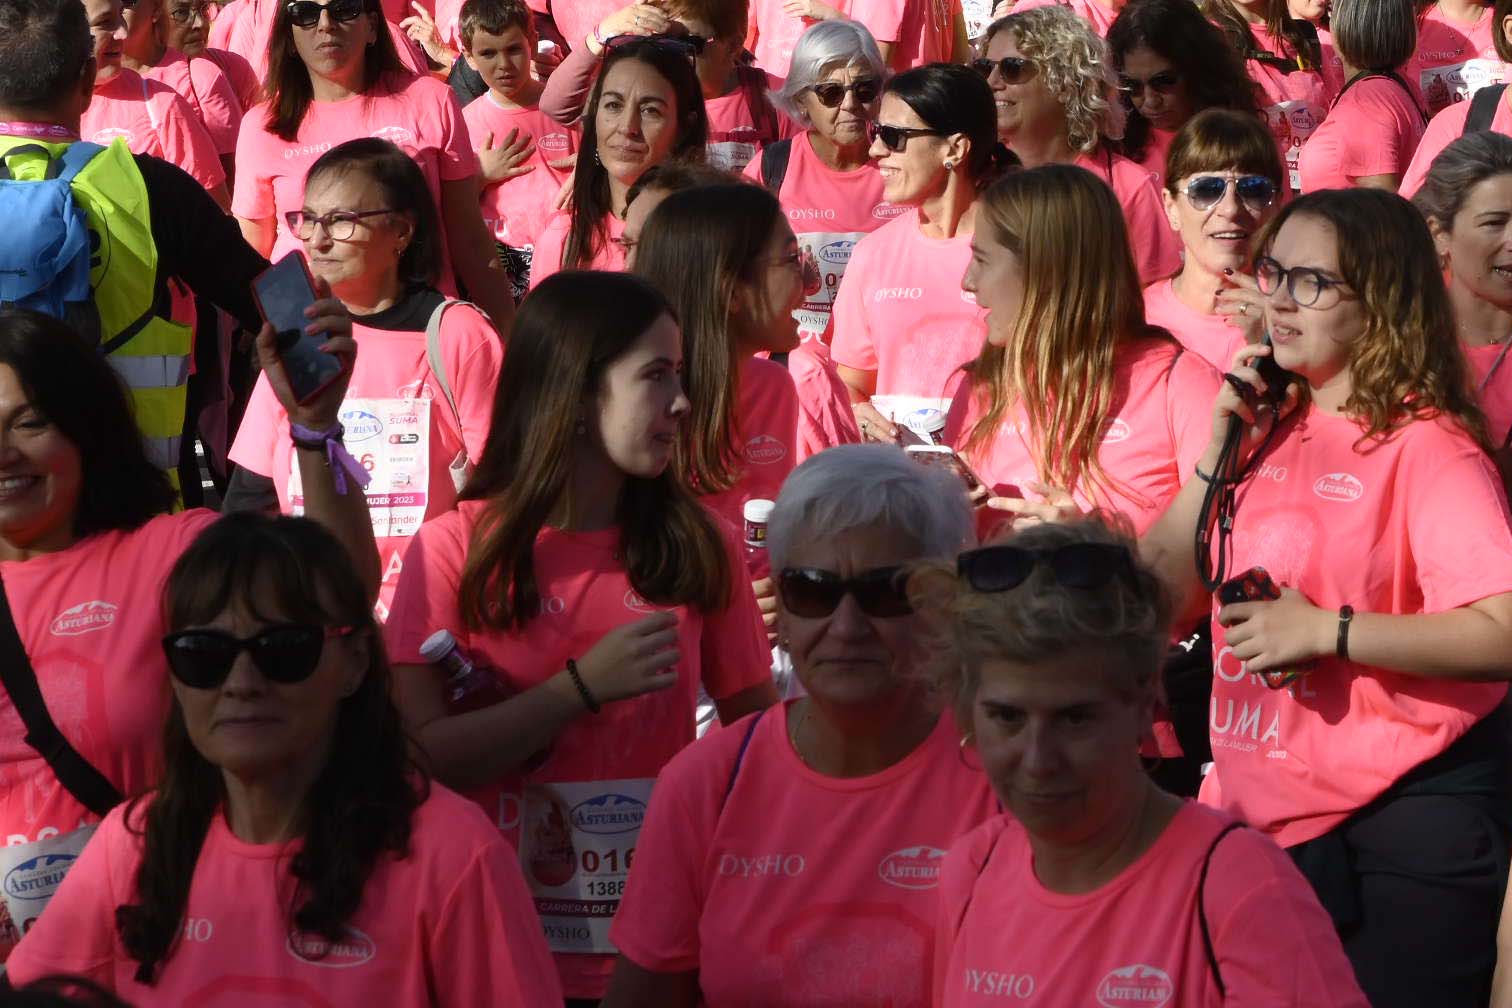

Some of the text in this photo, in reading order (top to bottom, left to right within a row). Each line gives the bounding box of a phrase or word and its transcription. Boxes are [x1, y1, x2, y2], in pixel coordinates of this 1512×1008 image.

[789, 208, 835, 220] OYSHO
[389, 416, 418, 425] SUMA
[393, 495, 416, 504] 2023
[56, 612, 116, 631] ASTURIANA
[1210, 696, 1281, 748] UMA
[591, 904, 607, 914] DE
